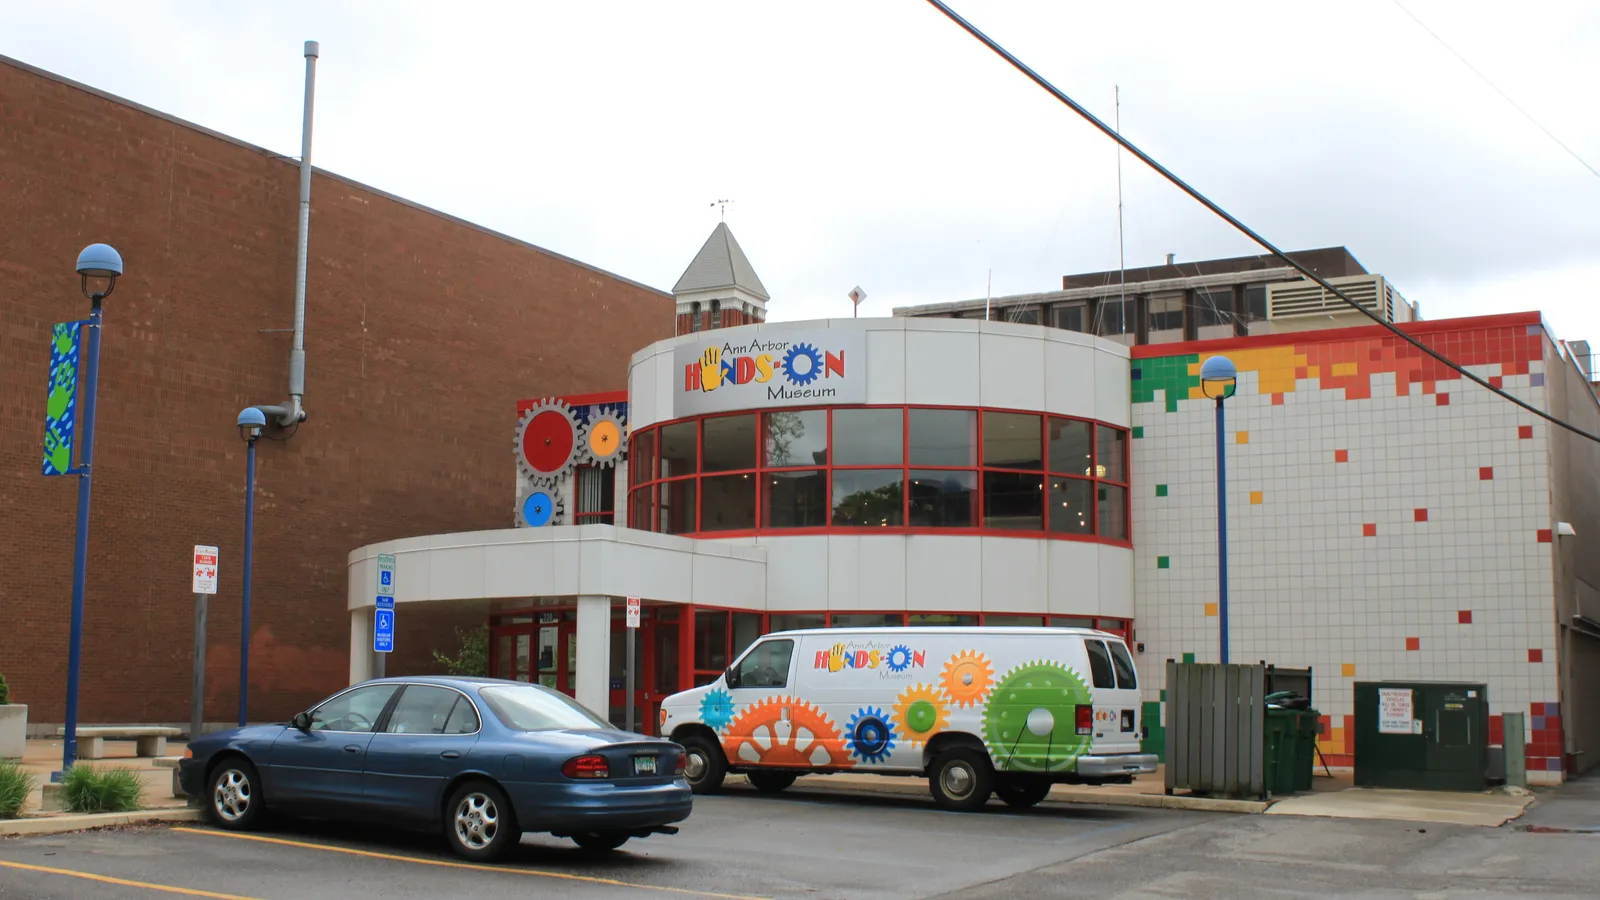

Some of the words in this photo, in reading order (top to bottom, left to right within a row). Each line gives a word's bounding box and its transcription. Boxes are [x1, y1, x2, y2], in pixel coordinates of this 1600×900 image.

[721, 342, 747, 355] Ann
[749, 339, 789, 353] Arbor
[767, 385, 836, 400] Museum
[846, 640, 865, 649] Ann
[865, 640, 891, 649] Arbor
[880, 671, 913, 680] Museum
